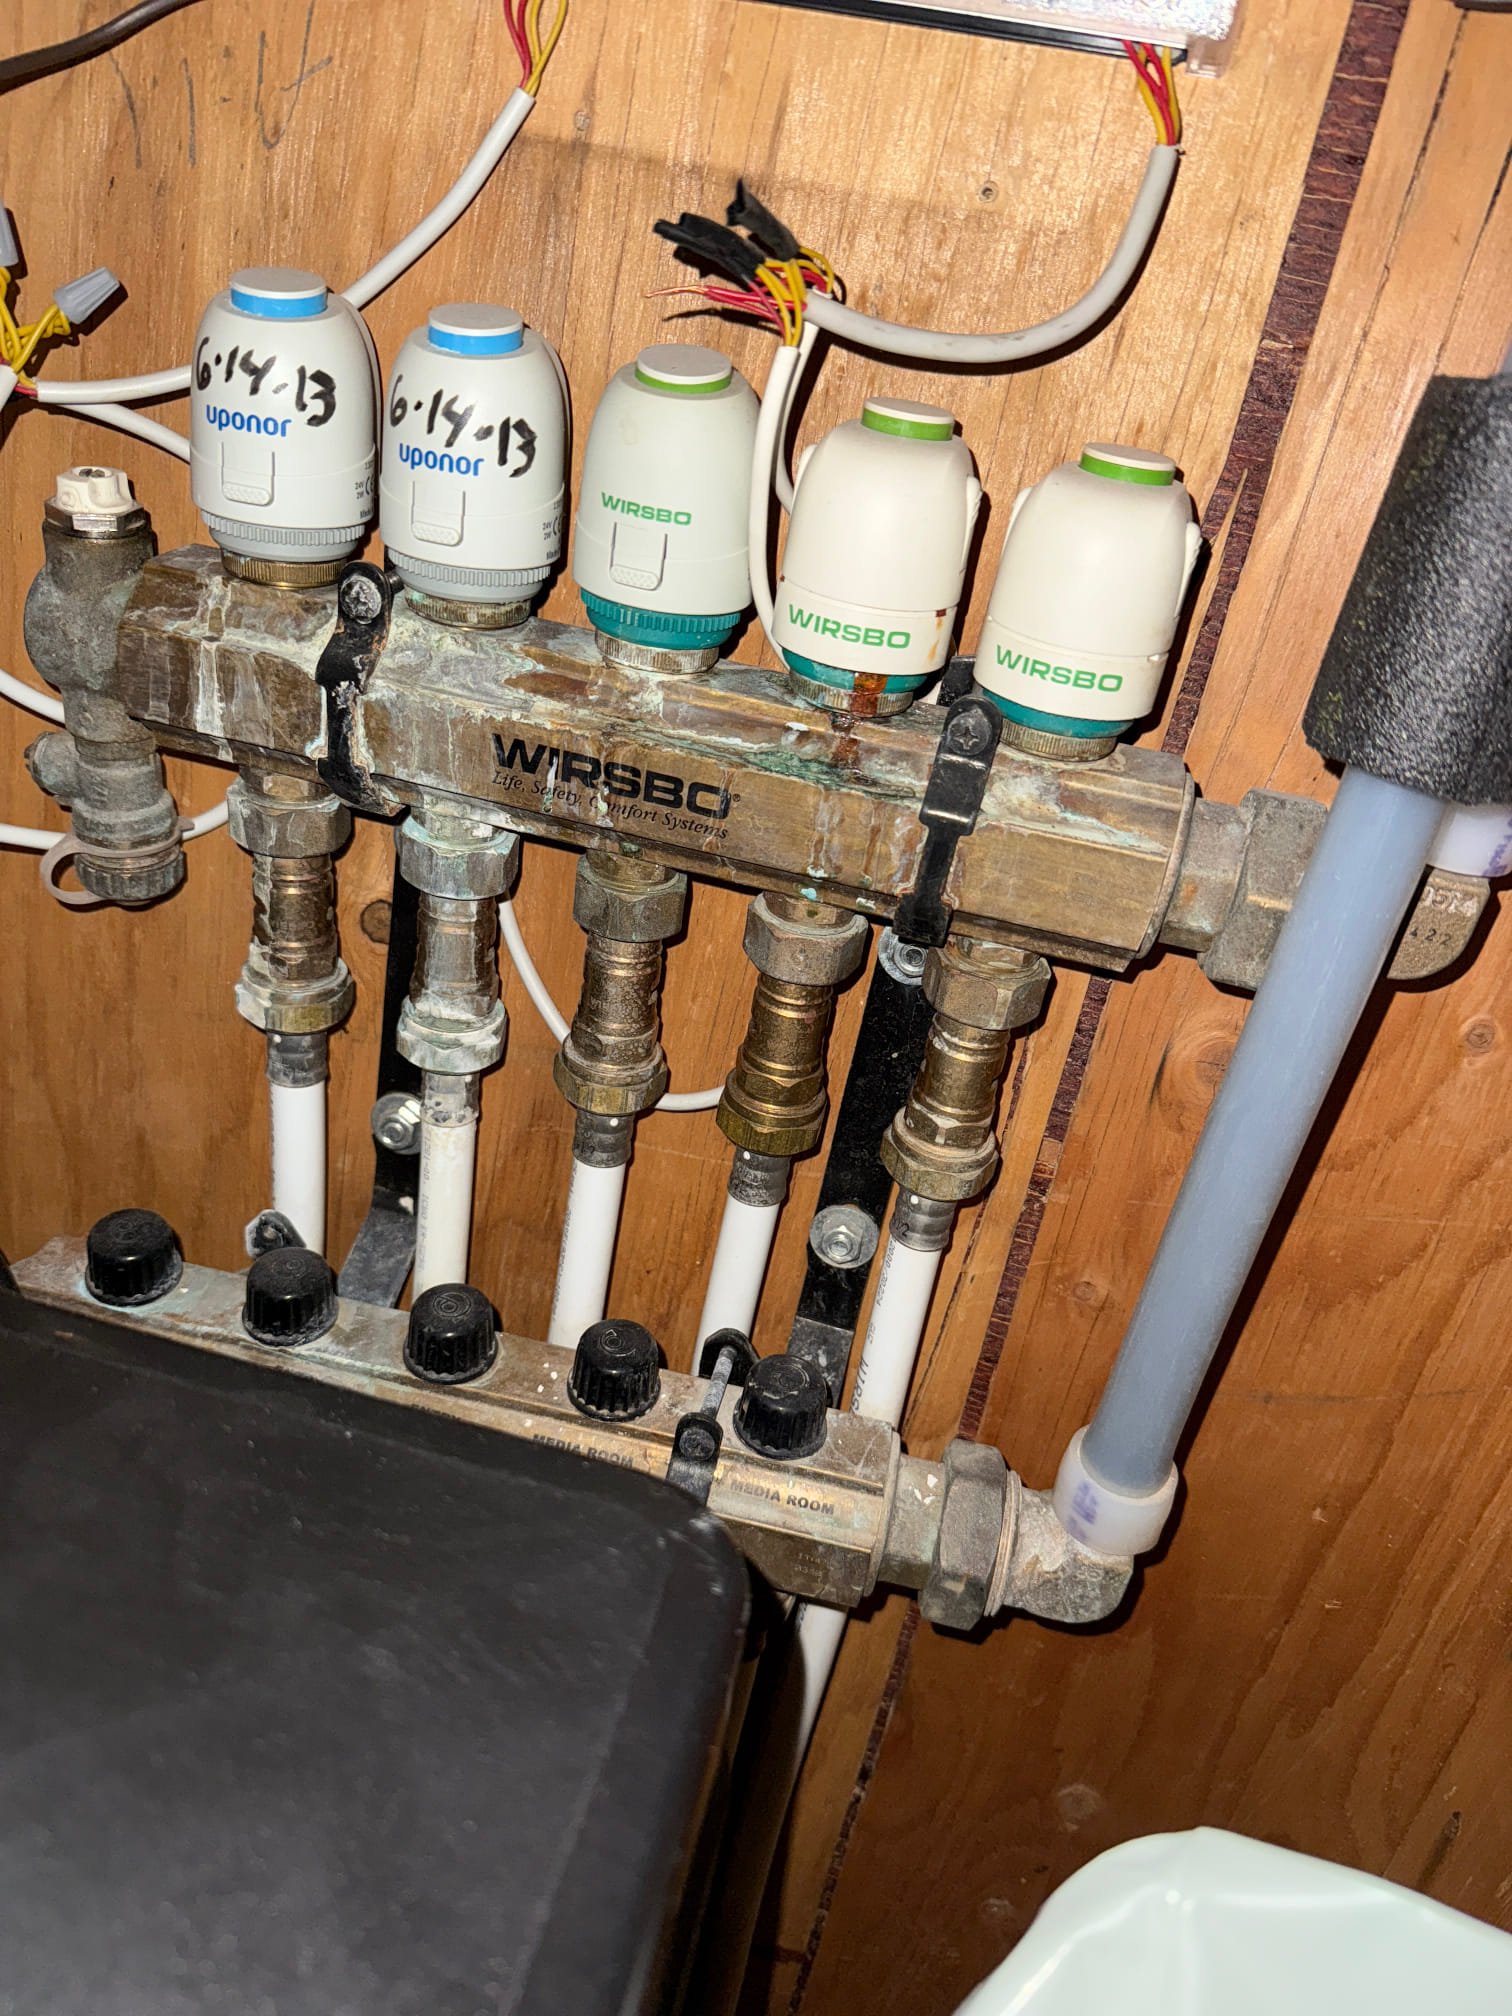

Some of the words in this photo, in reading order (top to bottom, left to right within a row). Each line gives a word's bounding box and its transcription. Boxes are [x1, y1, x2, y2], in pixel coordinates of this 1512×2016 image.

[206, 404, 292, 438] uponor
[399, 442, 485, 476] uponor
[601, 491, 693, 526] WIRSBO
[788, 603, 912, 649] WIRSBO
[996, 643, 1124, 693] WIRSBO
[492, 770, 526, 793] Life,
[588, 795, 658, 820] Cmfort
[661, 811, 729, 840] Systems
[586, 1446, 635, 1469] ROOM
[730, 1480, 781, 1503] MEDIA
[786, 1494, 836, 1516] ROOM
